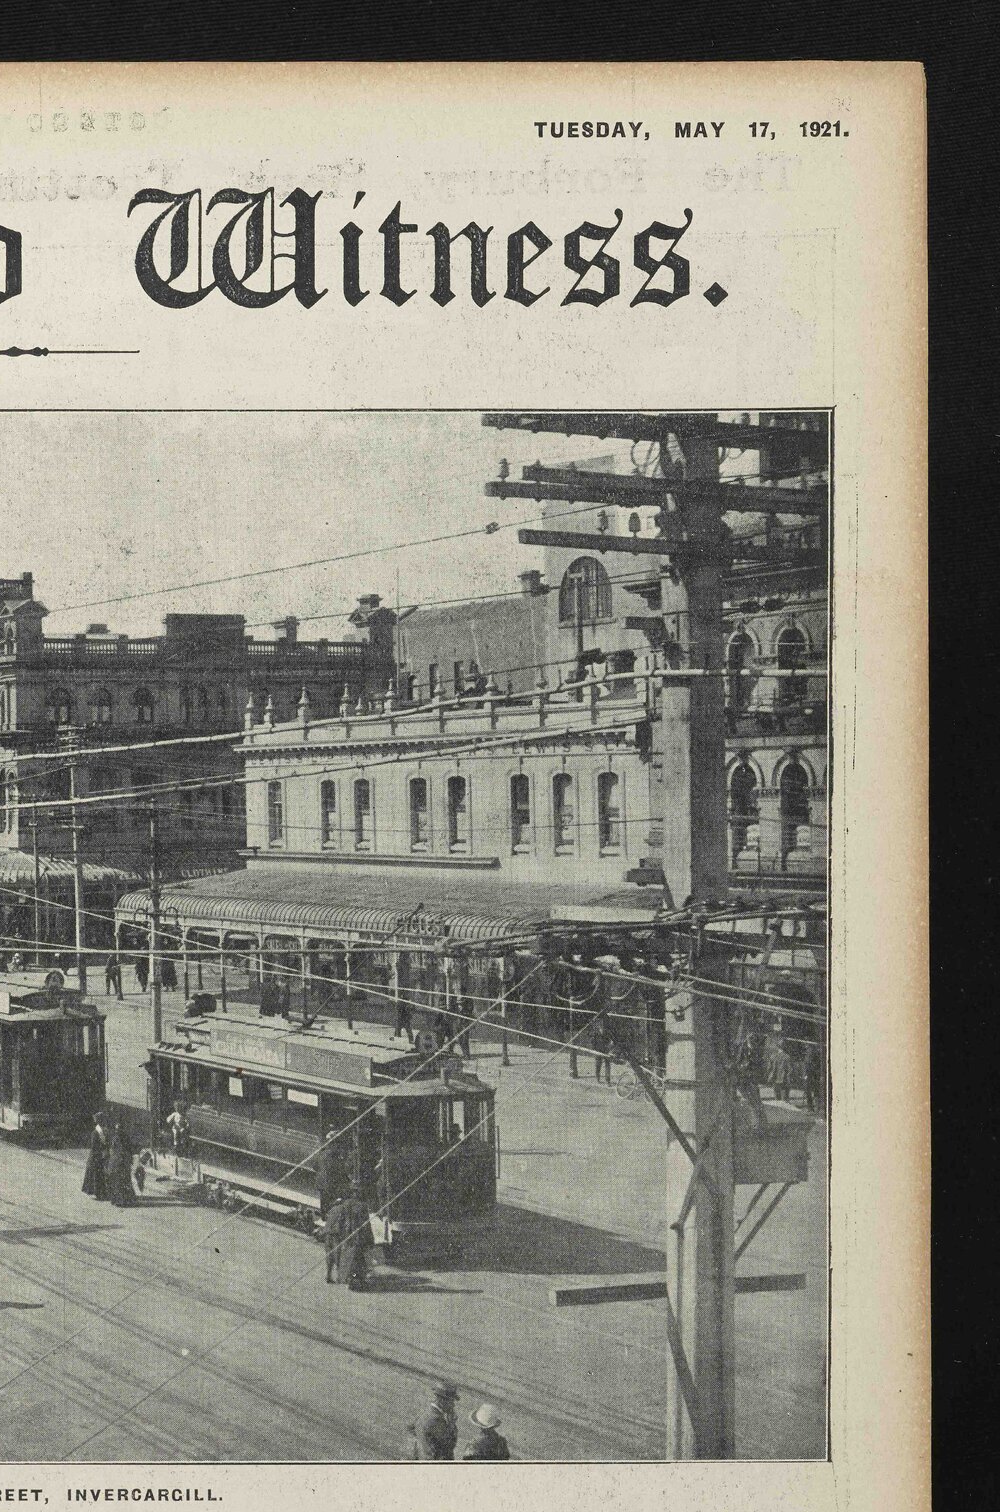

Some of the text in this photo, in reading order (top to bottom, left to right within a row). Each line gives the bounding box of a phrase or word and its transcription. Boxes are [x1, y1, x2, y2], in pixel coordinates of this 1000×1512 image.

[534, 121, 849, 140] TUESDAY, MAY 17, 1921.
[127, 187, 728, 309] Witness.
[68, 1489, 223, 1502] INVERCARGILL.
